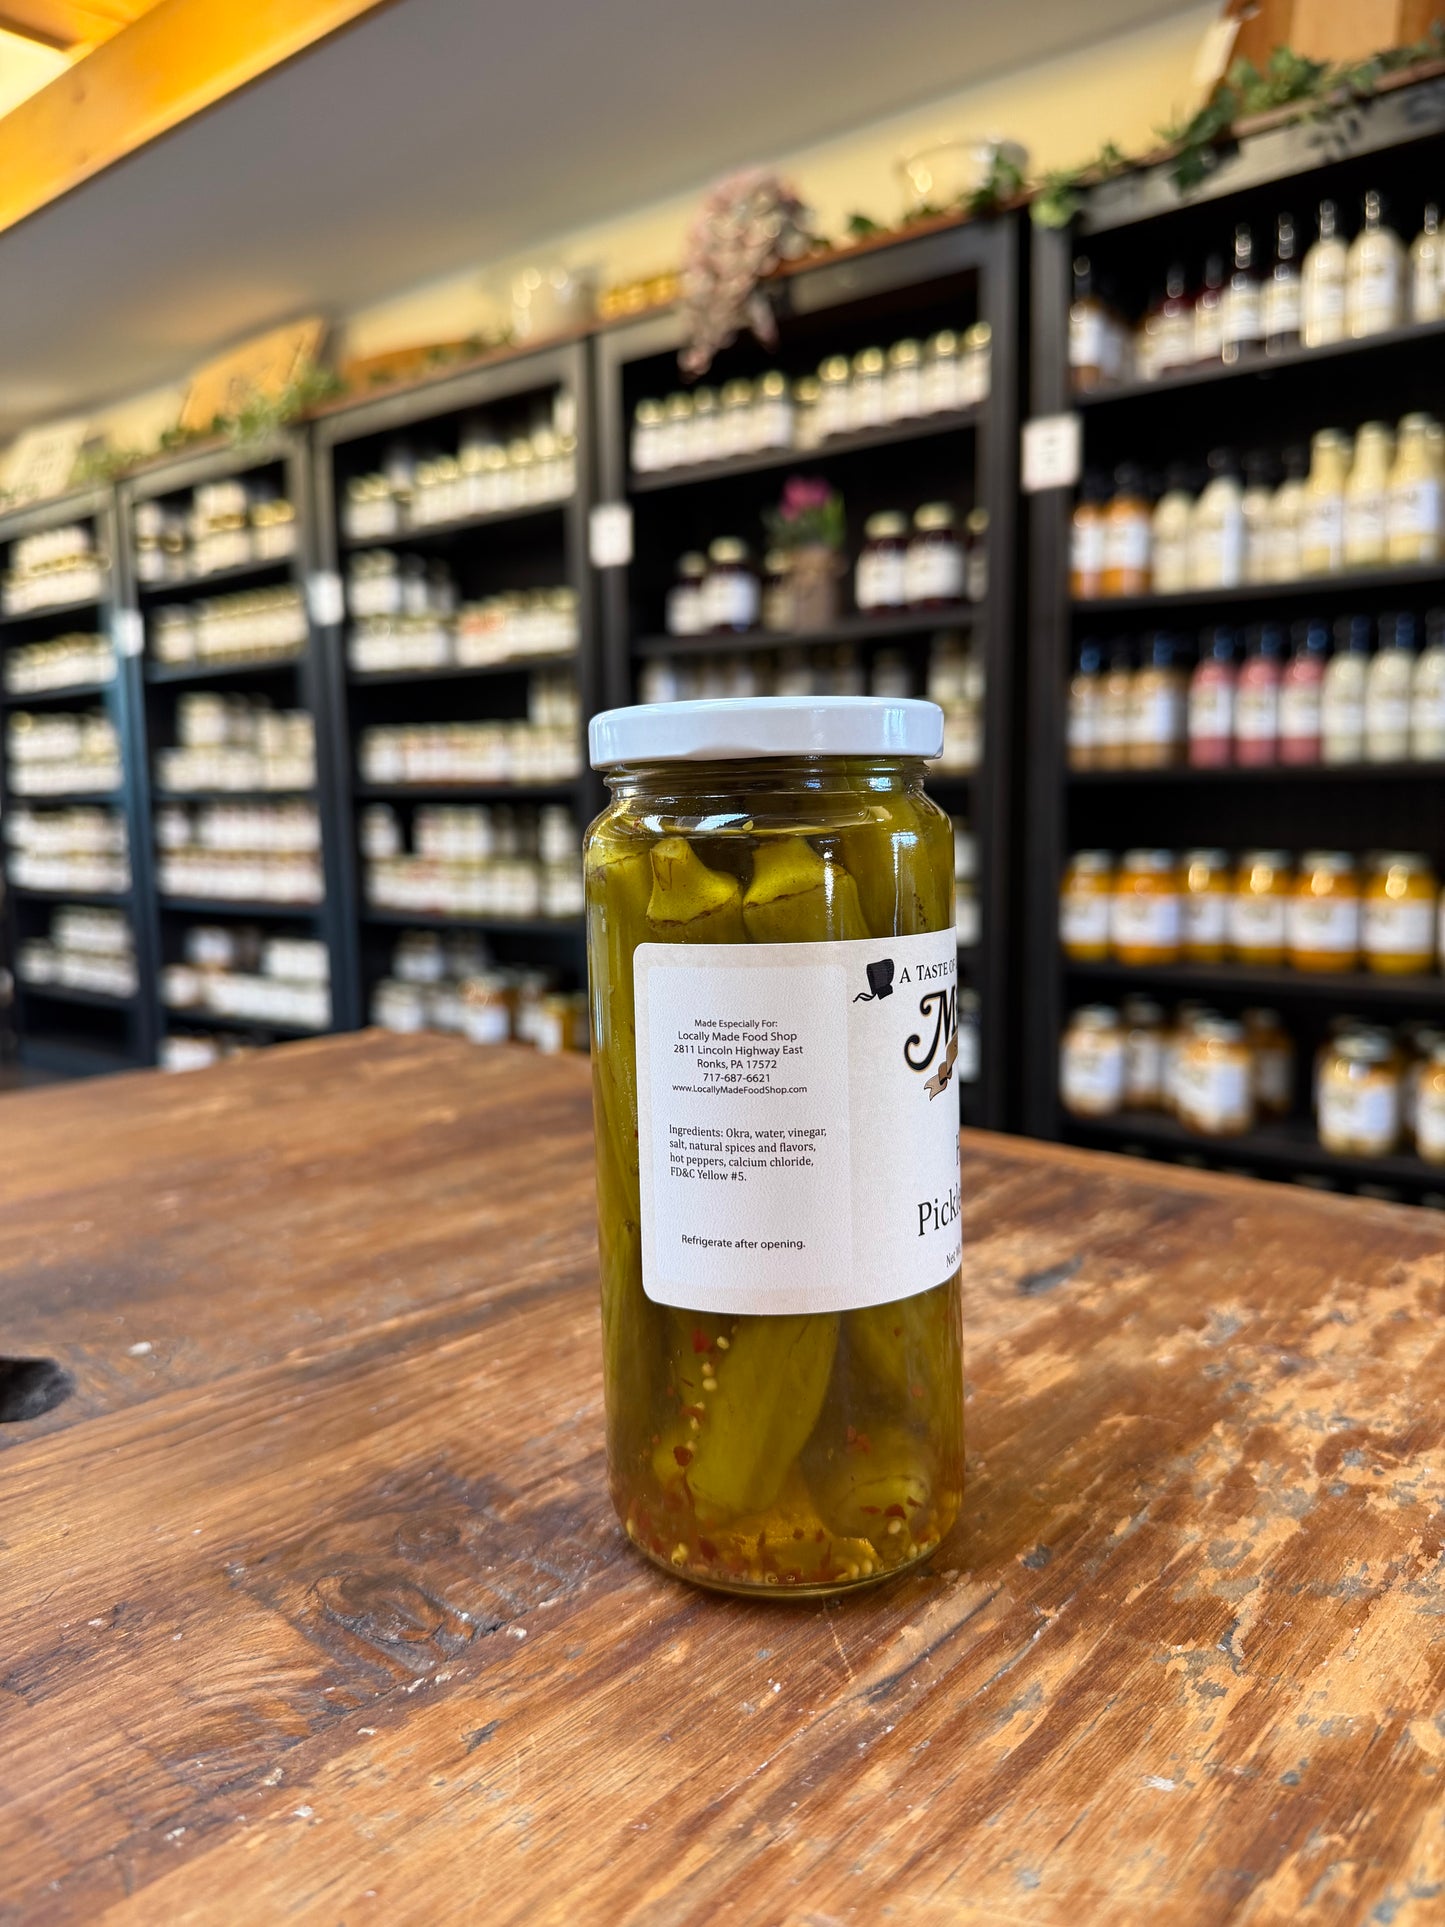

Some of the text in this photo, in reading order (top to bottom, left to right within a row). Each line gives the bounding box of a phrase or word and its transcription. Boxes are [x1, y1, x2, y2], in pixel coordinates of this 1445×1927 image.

[899, 967, 911, 984] A
[916, 961, 948, 981] TASTE
[694, 1019, 778, 1029] Made Especially For:
[678, 1031, 797, 1042] Locally Made Food Shop
[674, 1045, 803, 1057] 2811 Lincoln Highway East
[697, 1059, 777, 1070] Ronks, PA 17572
[703, 1073, 770, 1082] 717-687-6621
[672, 1085, 807, 1095] www.LocallyMadeFoodShop.com
[669, 1125, 827, 1139] Ingredients: Okra, water, vinegar,
[669, 1139, 816, 1154] salt, natural spices and flavors,
[670, 1153, 813, 1168] hot peppers, calcium chloride,
[670, 1167, 747, 1181] FD&C Yellow #5.
[682, 1235, 805, 1250] Refrigerate after opening.
